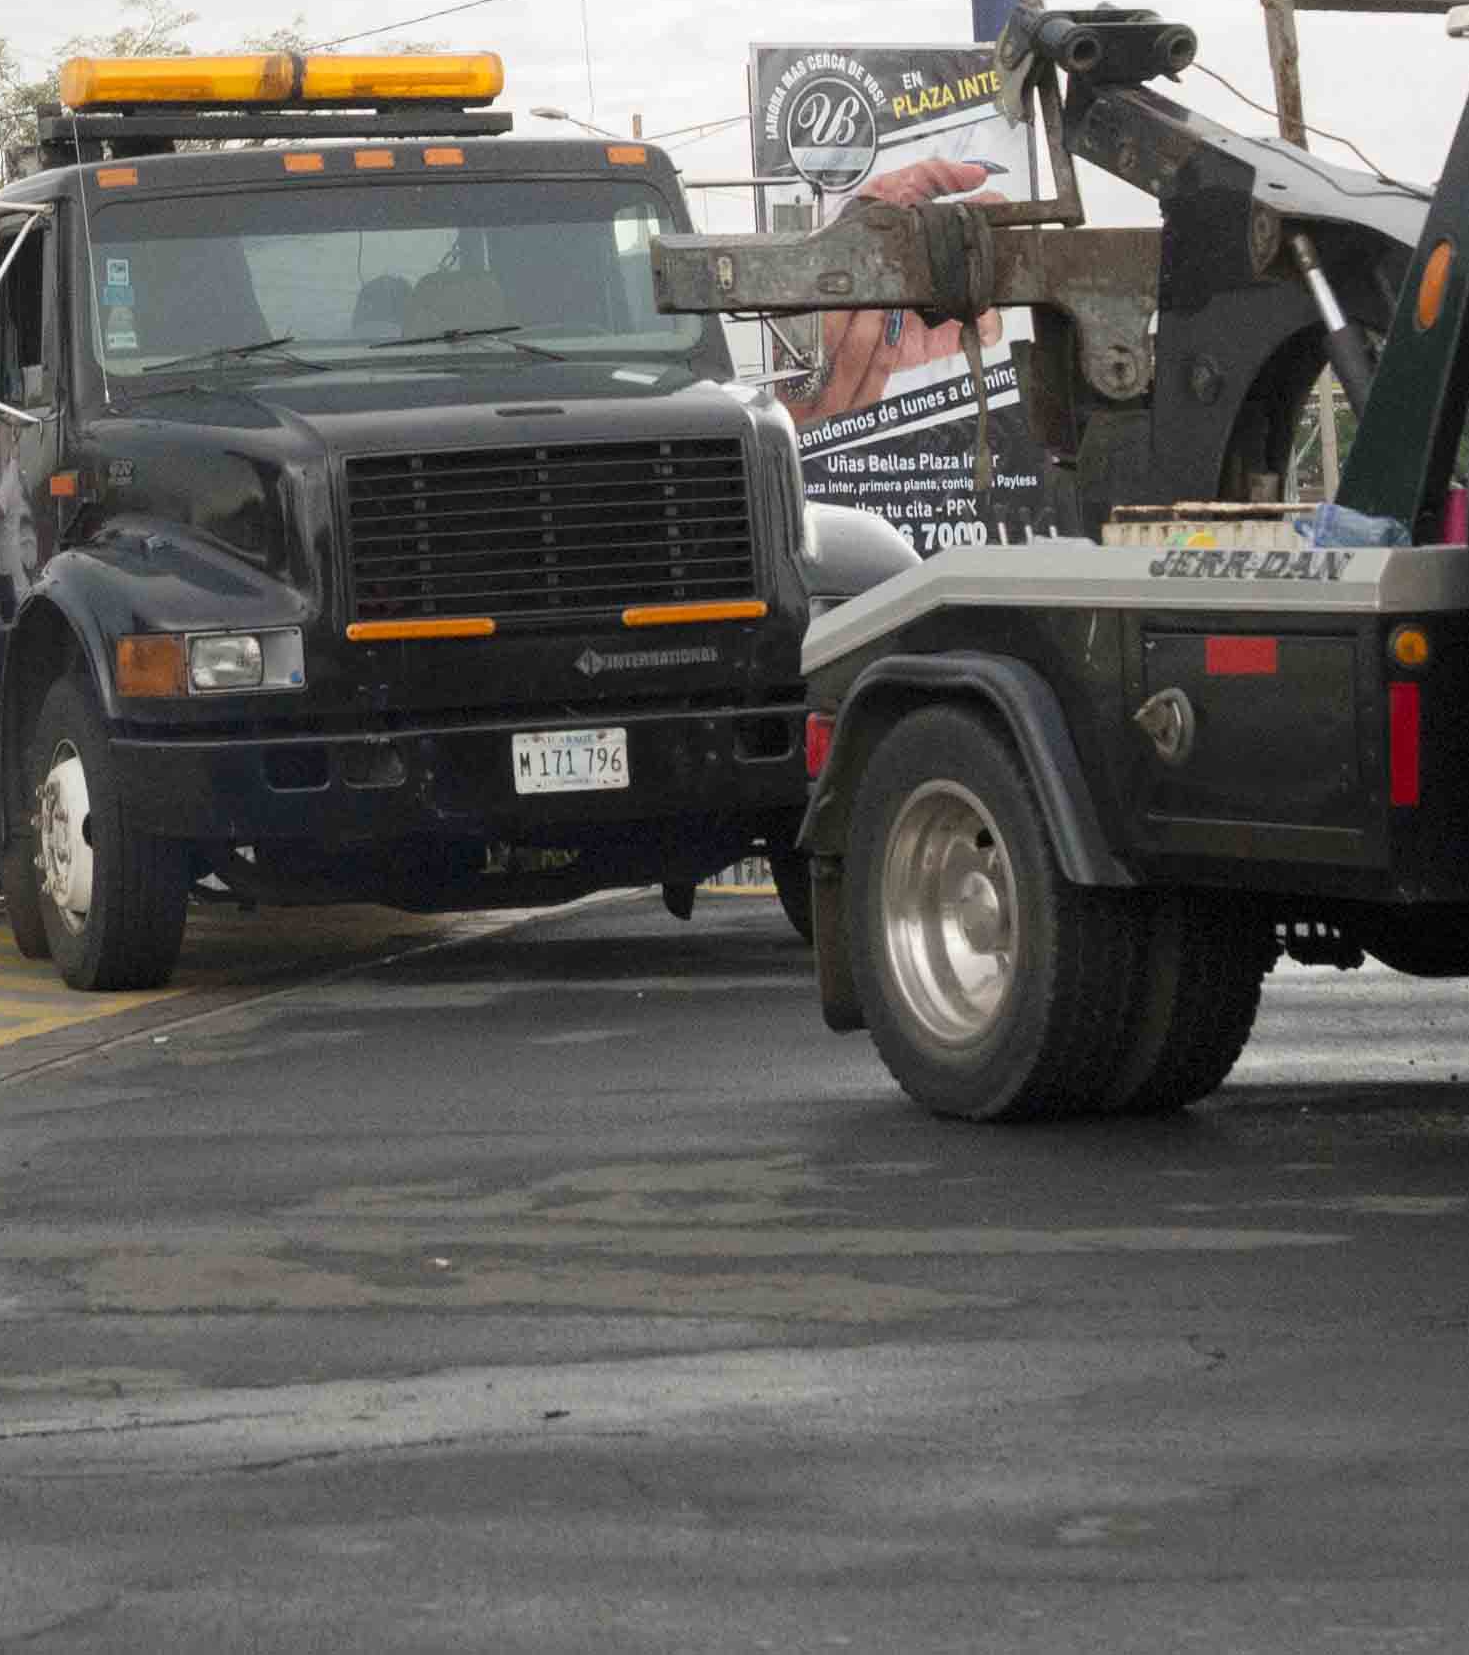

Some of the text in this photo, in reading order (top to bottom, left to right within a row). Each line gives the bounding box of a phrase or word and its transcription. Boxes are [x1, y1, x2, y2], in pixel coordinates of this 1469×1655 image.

[807, 53, 847, 72] CERCA
[847, 60, 865, 82] DE
[902, 70, 924, 90] EN
[891, 70, 1001, 121] PLAZA INTE
[796, 411, 876, 450] tendemos
[878, 403, 899, 424] de
[900, 391, 946, 416] lunes
[948, 386, 959, 402] a
[827, 455, 866, 474] Uñas
[868, 453, 917, 472] Bellas
[919, 453, 960, 471] Plaza
[803, 482, 826, 495] laza
[828, 480, 857, 496] Inter,
[859, 479, 902, 496] primera
[997, 474, 1038, 490] Payless
[886, 502, 903, 518] tu
[905, 500, 933, 518] cita
[1149, 549, 1354, 581] JERR-DAN
[606, 647, 720, 670] INTERNATIONAL
[519, 746, 623, 777] M 171 796
